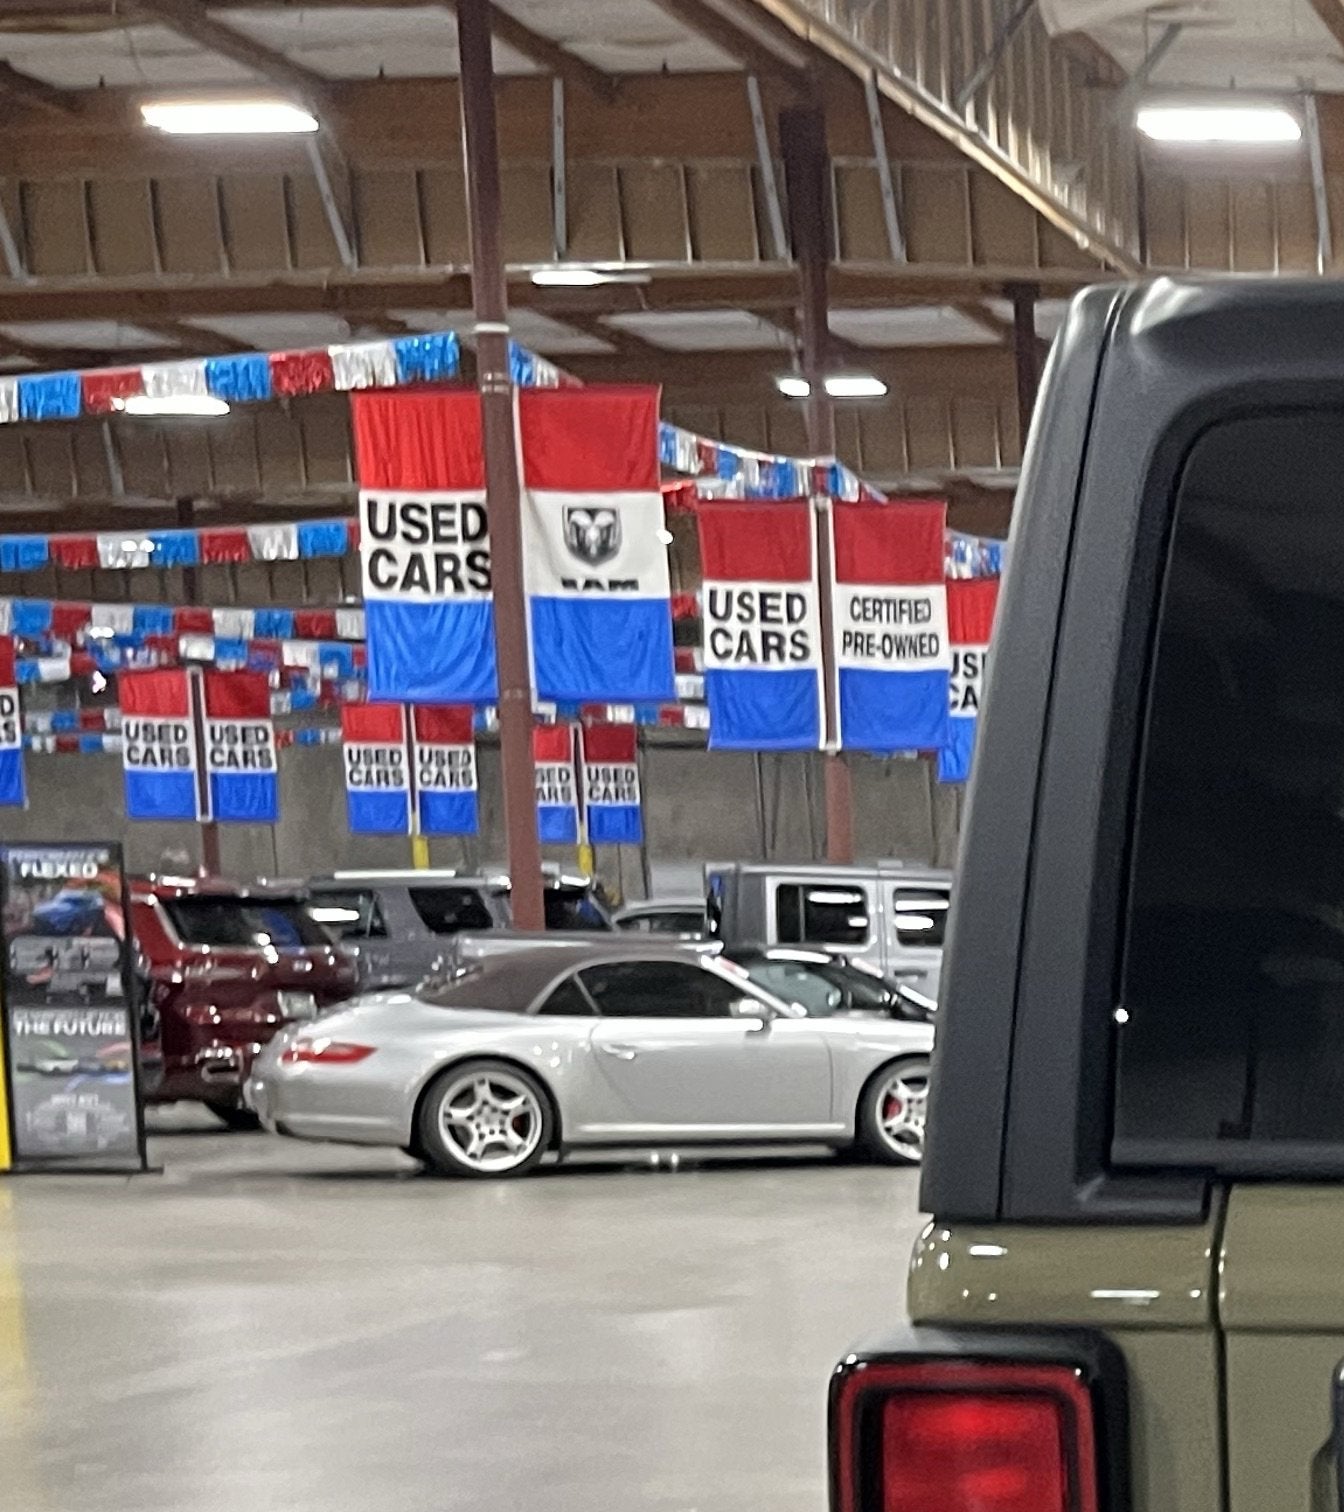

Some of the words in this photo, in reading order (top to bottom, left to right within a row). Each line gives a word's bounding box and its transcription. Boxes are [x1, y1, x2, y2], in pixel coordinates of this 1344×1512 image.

[367, 499, 488, 545] USED
[368, 548, 492, 595] CARS
[709, 589, 807, 624] USED
[850, 595, 931, 624] CERTIFIED
[710, 627, 811, 663] CARS
[842, 629, 940, 659] PRE-OWNED
[125, 722, 188, 744] USED
[210, 724, 269, 746] USED
[127, 745, 190, 767] CARS
[210, 748, 272, 768] CARS
[348, 748, 403, 766] USED
[419, 748, 472, 767] USED
